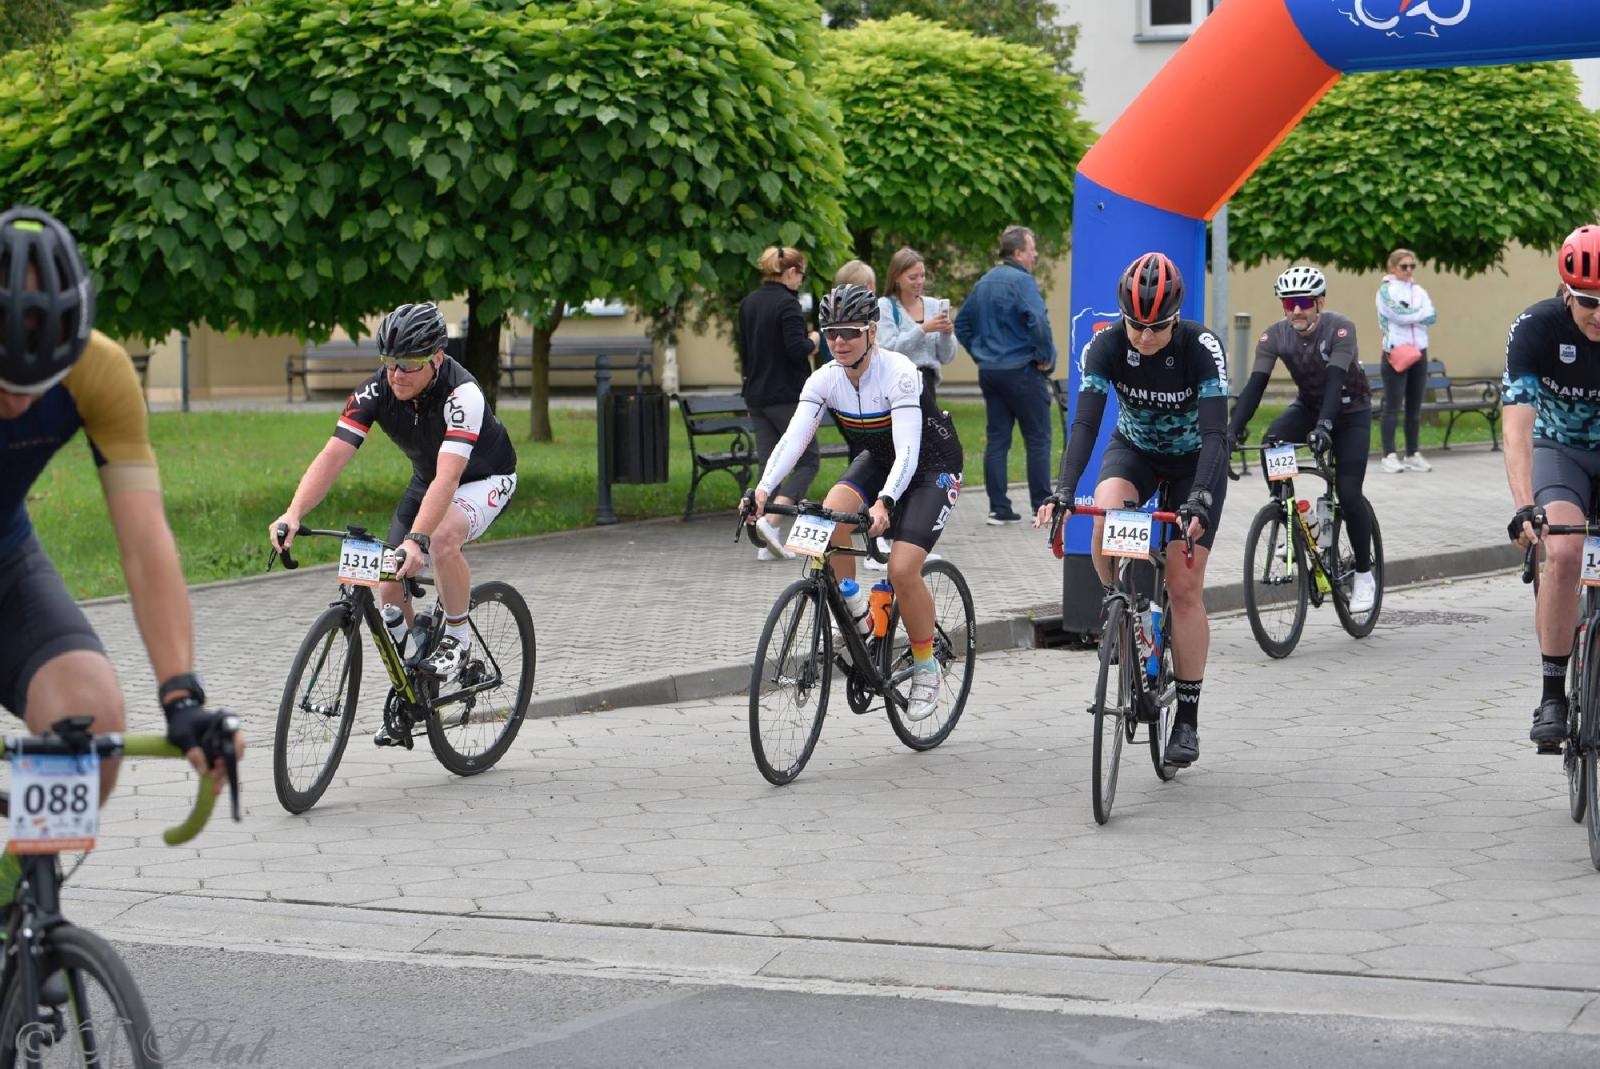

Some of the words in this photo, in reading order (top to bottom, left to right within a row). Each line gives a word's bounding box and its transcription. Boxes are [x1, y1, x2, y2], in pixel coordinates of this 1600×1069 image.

[1151, 386, 1193, 402] FONDO
[1541, 376, 1584, 397] GRAN
[1268, 456, 1294, 468] 1422
[793, 526, 829, 543] 1313
[1107, 525, 1149, 541] 1446
[342, 553, 380, 570] 1314
[24, 783, 88, 815] 088
